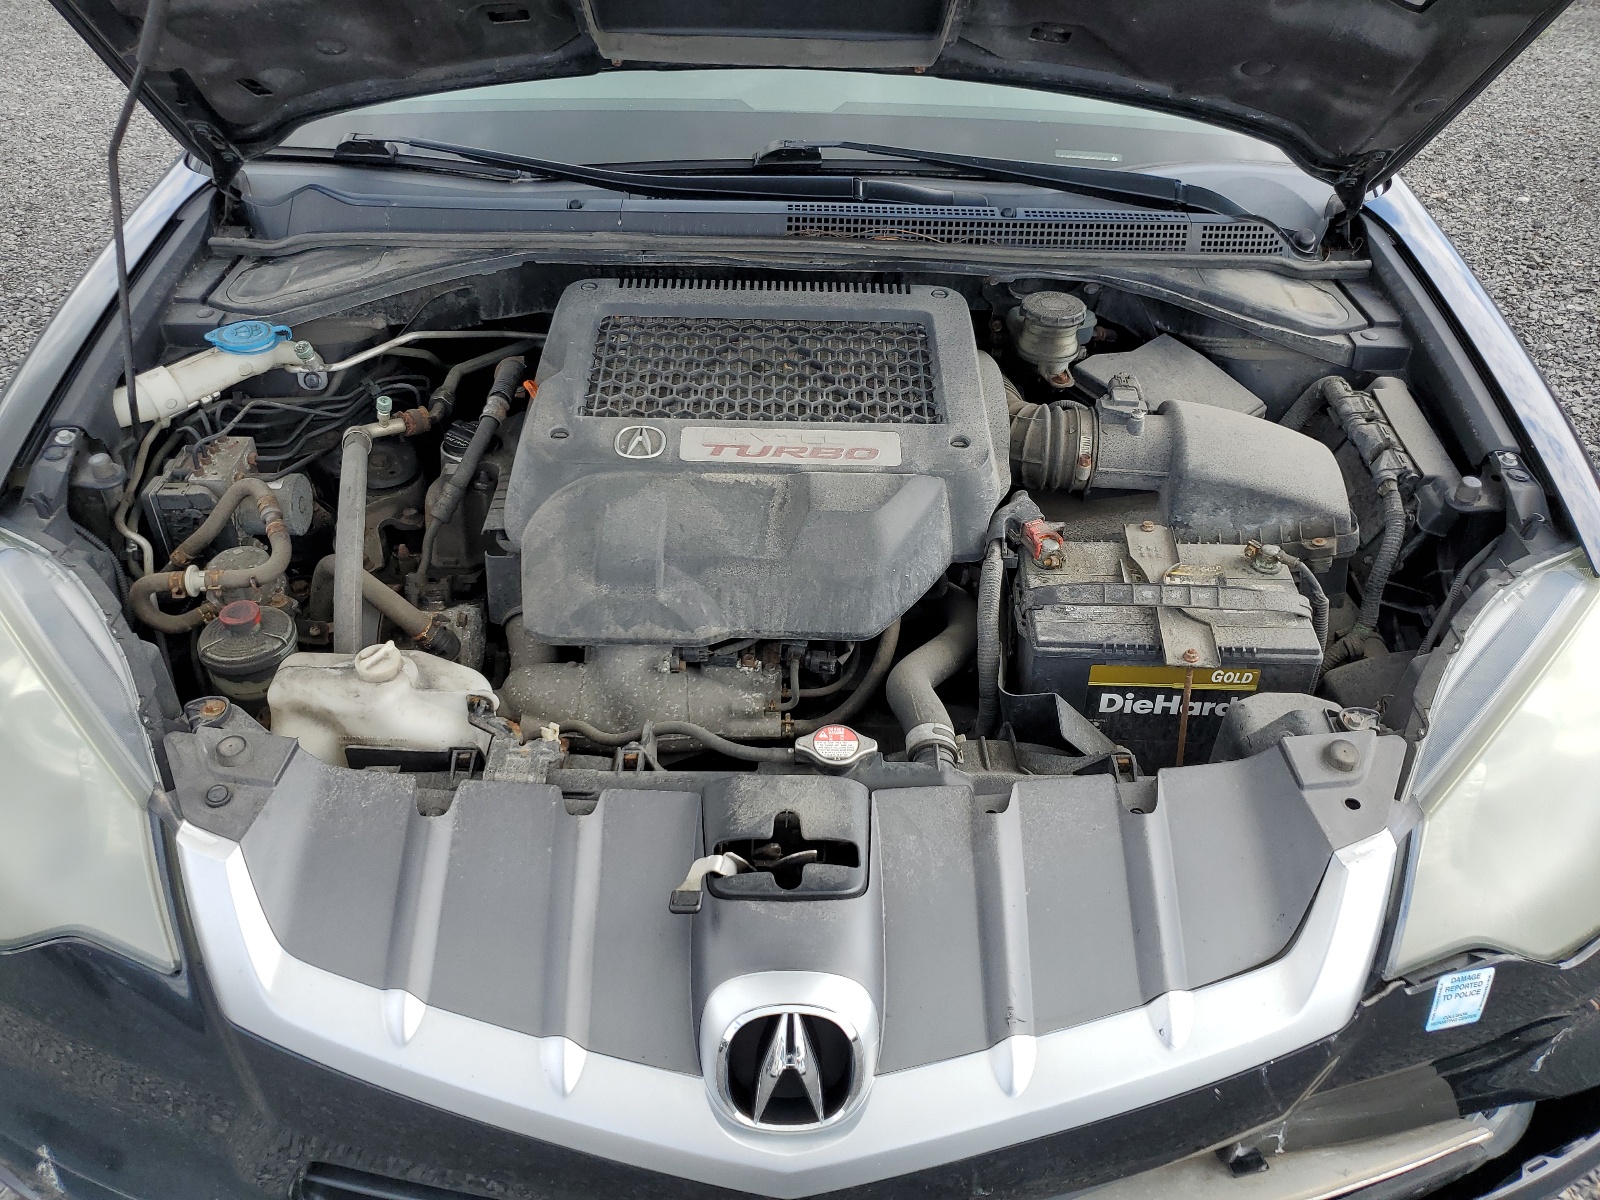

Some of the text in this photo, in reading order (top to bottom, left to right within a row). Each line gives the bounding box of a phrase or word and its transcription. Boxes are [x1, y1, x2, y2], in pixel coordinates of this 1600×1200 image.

[702, 443, 880, 461] TURBO
[1211, 669, 1253, 684] GOLD
[1451, 973, 1482, 984] DAMAGE
[1445, 981, 1483, 992] REPORTED
[1454, 989, 1481, 999] POLICE
